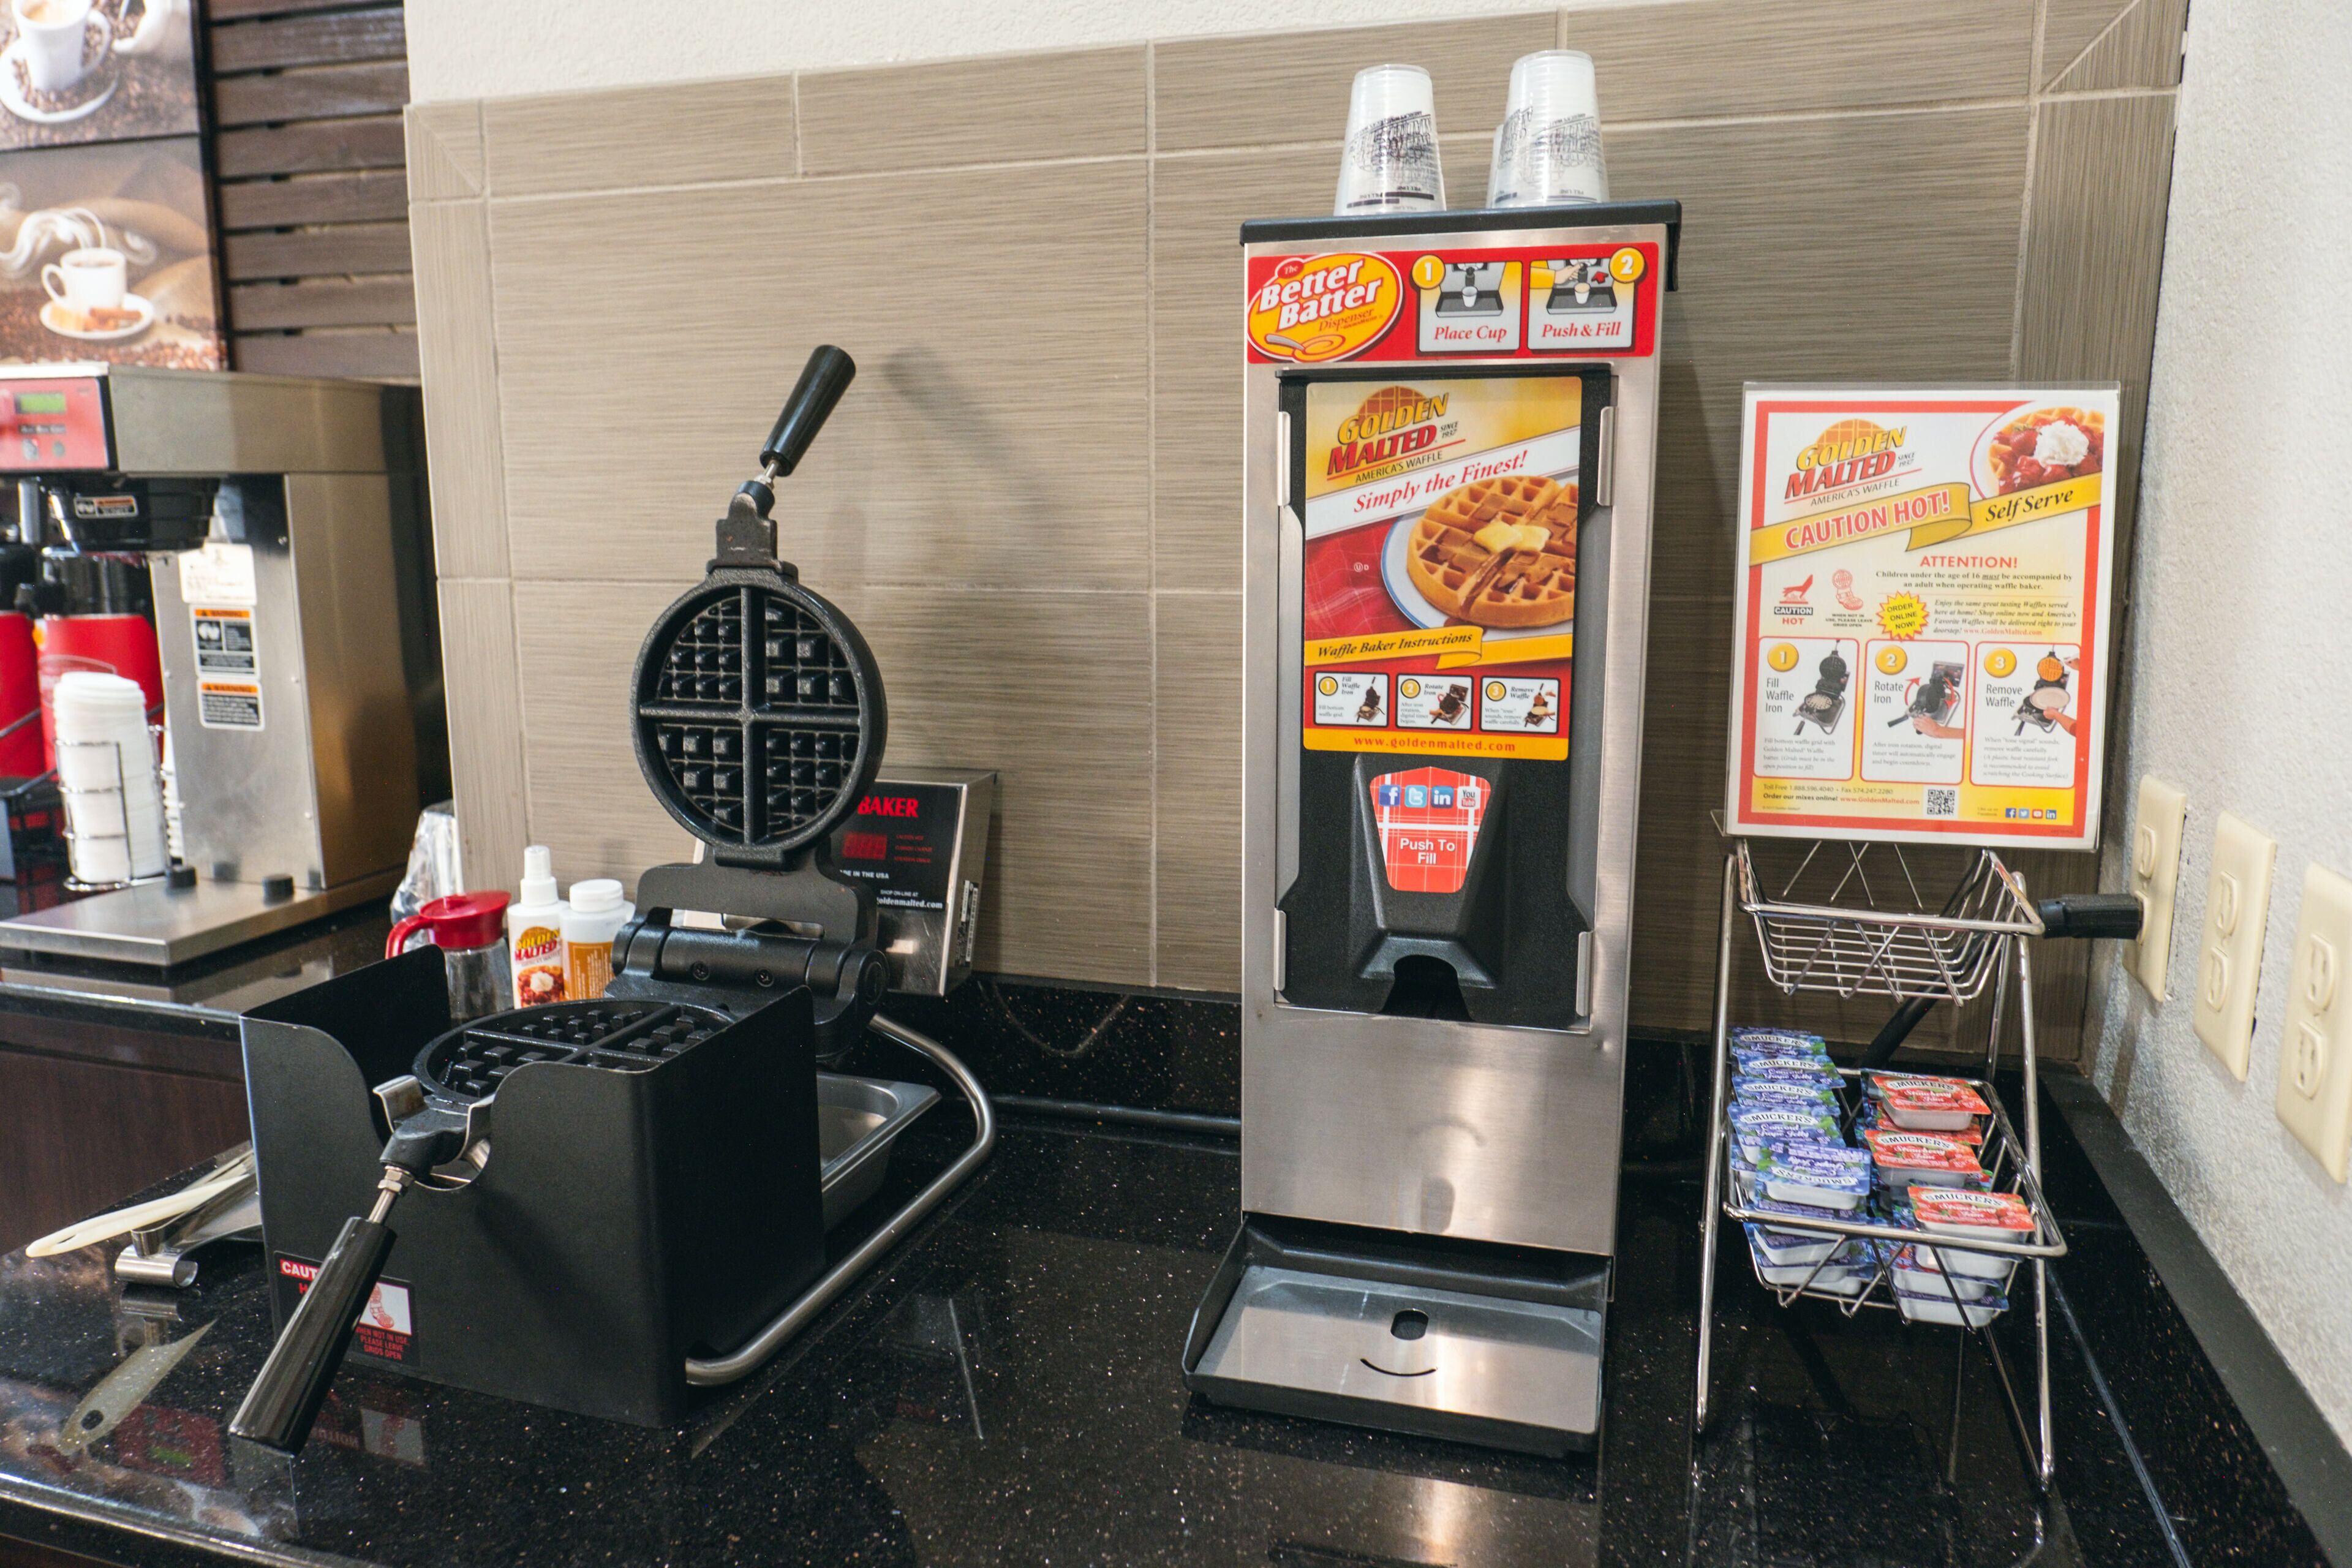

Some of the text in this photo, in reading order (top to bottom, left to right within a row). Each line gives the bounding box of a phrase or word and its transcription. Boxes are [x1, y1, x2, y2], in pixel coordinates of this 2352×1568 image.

[1284, 265, 1297, 274] The
[1425, 263, 1432, 281] 1
[1621, 255, 1634, 274] 2
[1259, 259, 1364, 313] Better
[1277, 279, 1382, 331] Batter
[1319, 308, 1374, 331] Dispenser
[1434, 326, 1507, 343] Place Cup
[1542, 322, 1621, 337] Push & Fill
[1338, 392, 1449, 445] GOLDEN
[1440, 421, 1459, 431] SINCE
[1327, 425, 1437, 475] MALTED
[1796, 426, 1907, 472] GOLDEN
[1355, 451, 1442, 483] AMERICA'S WAFFLE
[1354, 450, 1528, 513] Simply the Finest!
[1785, 451, 1896, 499] MALTED
[1811, 478, 1899, 507] AMERICA'S WAFFLE
[1986, 490, 2073, 521] Self Serve
[1785, 491, 1950, 549] CAUTION HOT!
[1920, 556, 2018, 568] ATTENTION!
[1887, 603, 1913, 612] ORDER
[1890, 611, 1917, 621] ONLINE
[1895, 621, 1915, 630] NOW!
[1318, 633, 1472, 658] Waffle Baker Instructions
[1886, 654, 1897, 667] 2
[1995, 656, 2006, 669] 3
[1766, 678, 1779, 688] Fill
[1874, 681, 1904, 692] Rotate
[1986, 684, 2022, 695] Remove
[1766, 690, 1794, 701] Waffle
[1874, 694, 1891, 704] Iron
[1986, 697, 2015, 707] Waffle
[1765, 703, 1782, 712] Iron
[1354, 737, 1515, 752] www.goldenmalted.com
[1463, 790, 1476, 798] You
[857, 795, 918, 818] BAKER
[1400, 838, 1455, 852] Push To
[1418, 852, 1437, 864] Fill
